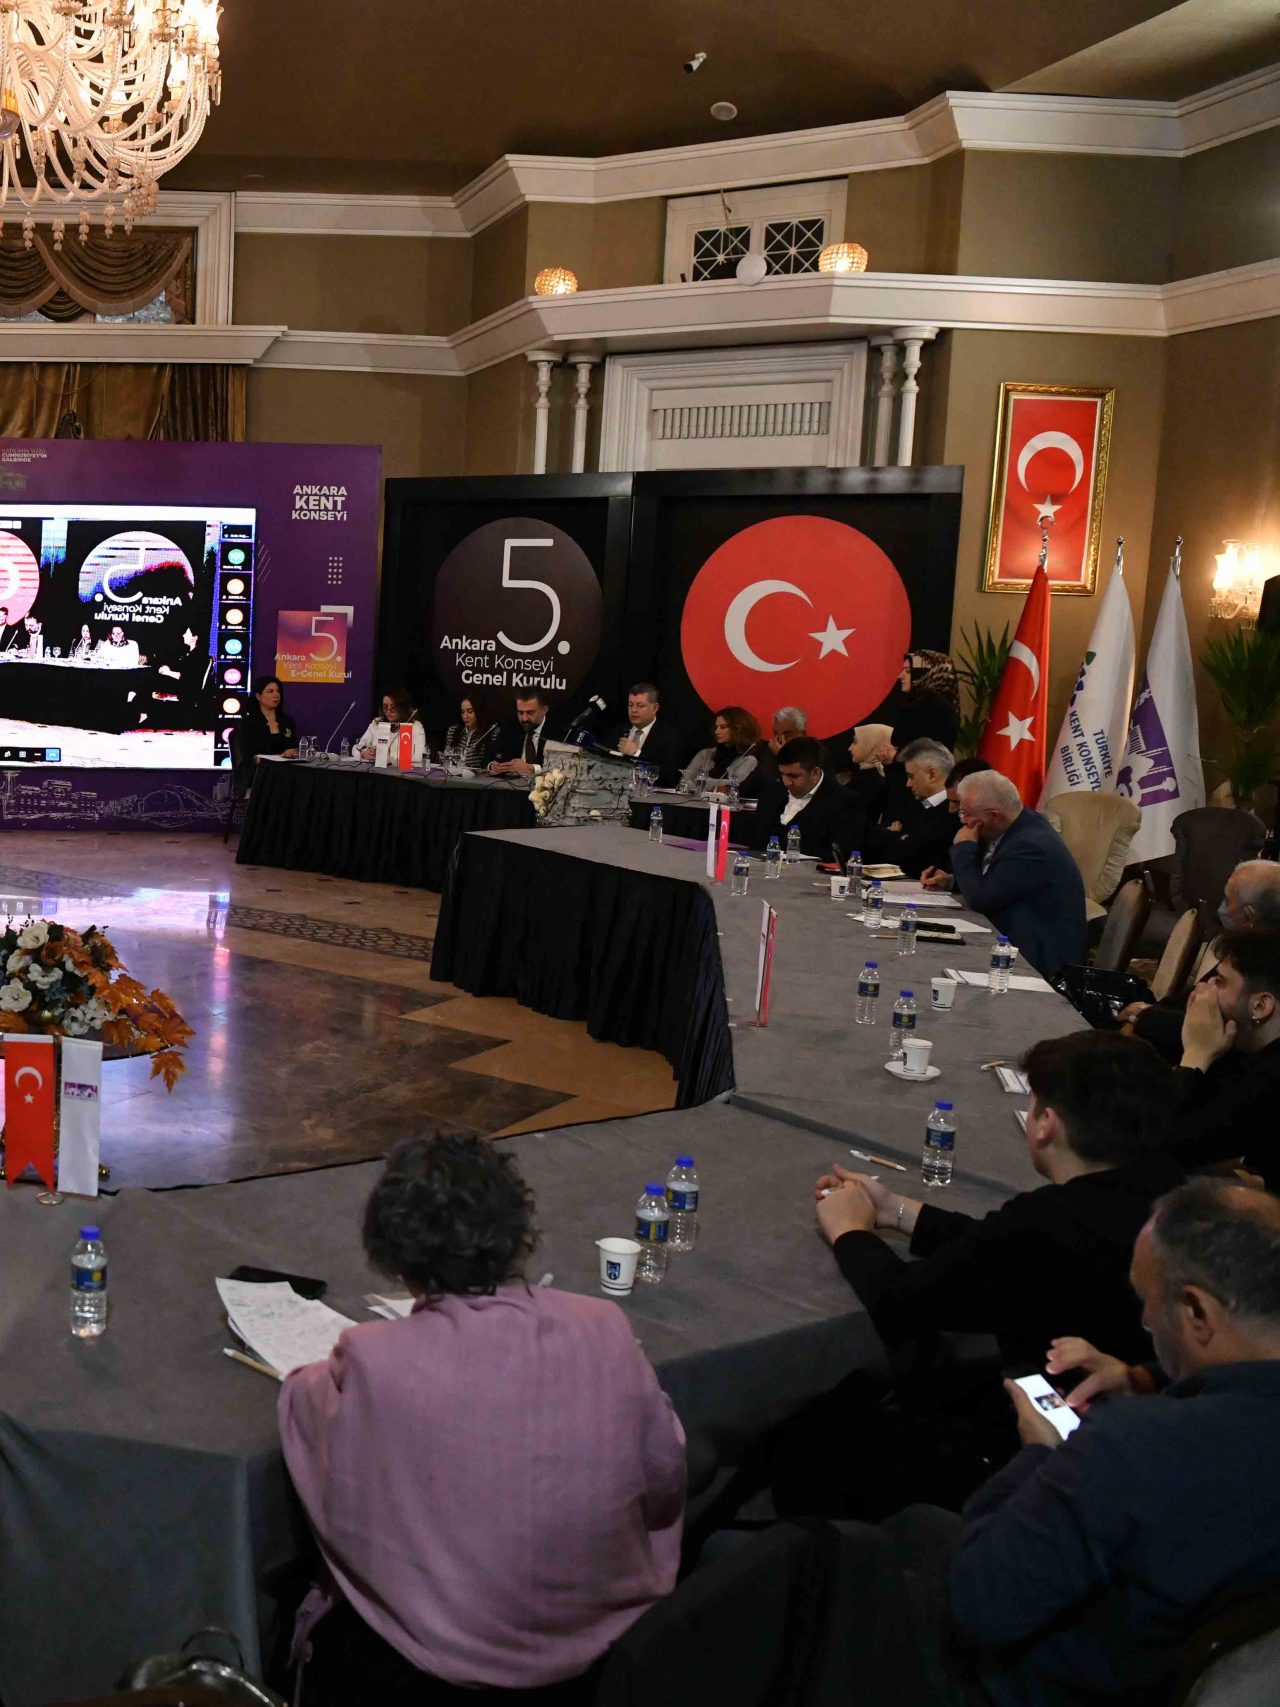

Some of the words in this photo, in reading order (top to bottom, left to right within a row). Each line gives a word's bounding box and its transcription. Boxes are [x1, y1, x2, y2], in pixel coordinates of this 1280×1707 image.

[293, 485, 347, 496] ANKARA
[295, 496, 345, 511] KENT
[497, 538, 570, 655] 5.
[309, 616, 342, 661] 5.
[440, 635, 496, 651] Ankara
[274, 653, 306, 661] Ankara
[455, 652, 489, 668] Kent
[494, 655, 554, 674] Konseyi
[291, 669, 326, 678] E-Genel
[461, 669, 507, 686] Genel
[512, 672, 567, 690] Kurulu
[1069, 710, 1085, 739] KENT
[1093, 729, 1114, 779] TÜRKİYE
[1060, 745, 1084, 787] BİRLİĞİ
